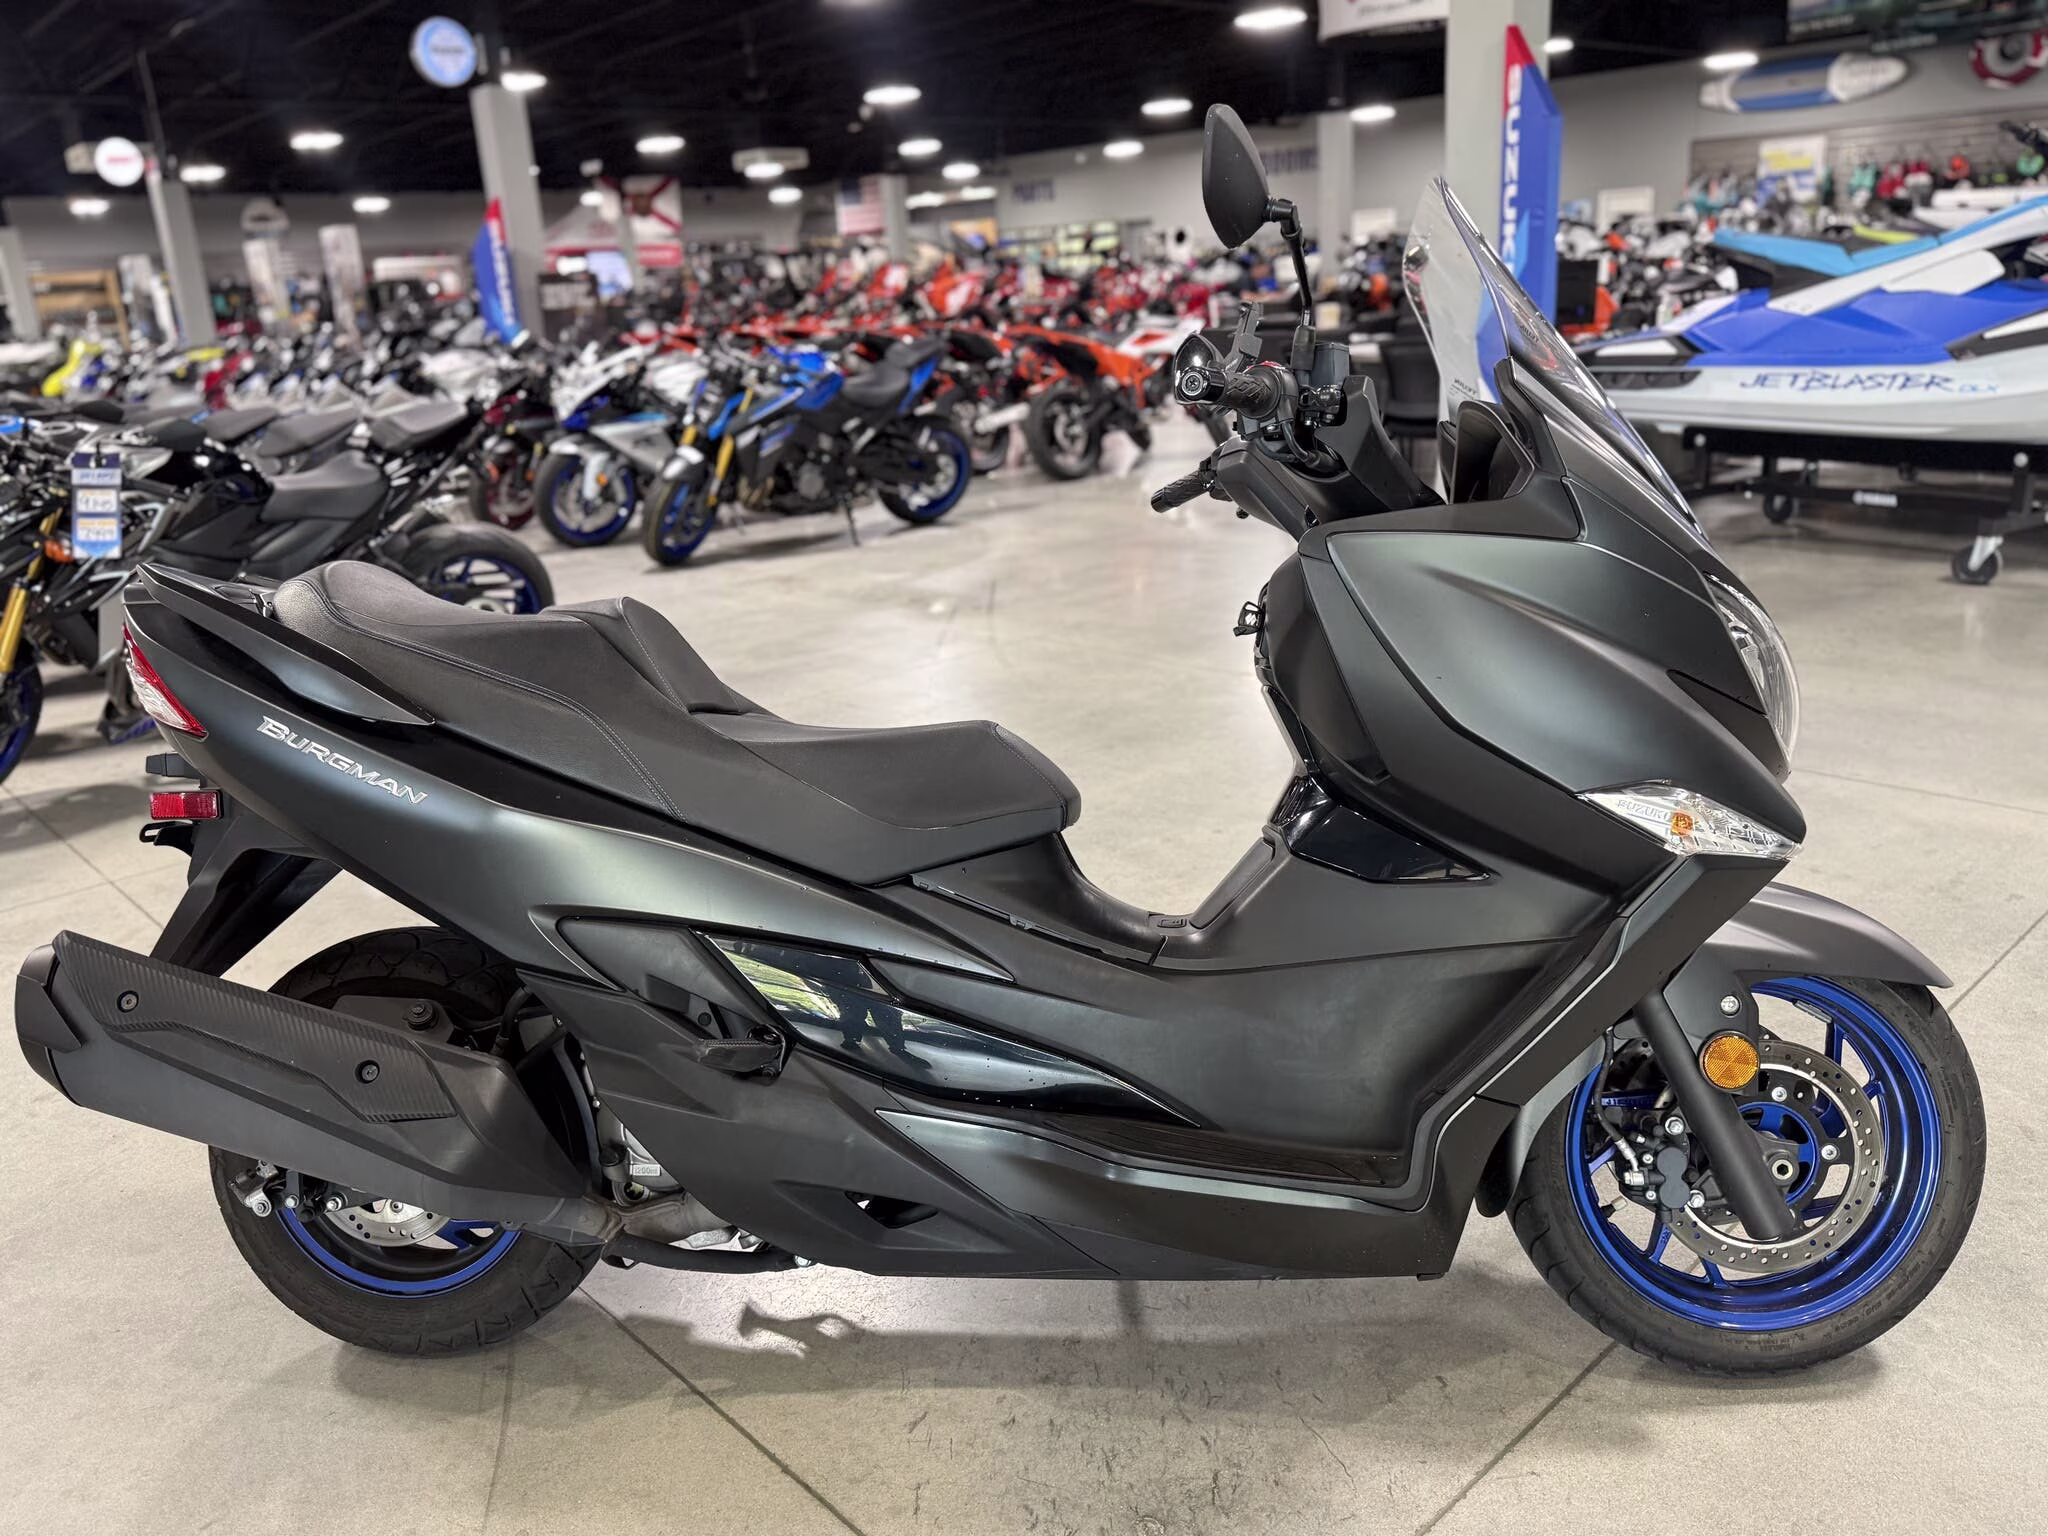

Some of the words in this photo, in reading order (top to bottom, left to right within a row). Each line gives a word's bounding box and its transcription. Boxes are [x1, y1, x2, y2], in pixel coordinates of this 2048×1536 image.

[1740, 371, 1954, 392] JETBLASTER
[257, 715, 428, 804] BURGMAN
[1617, 799, 1669, 821] SUZUKI
